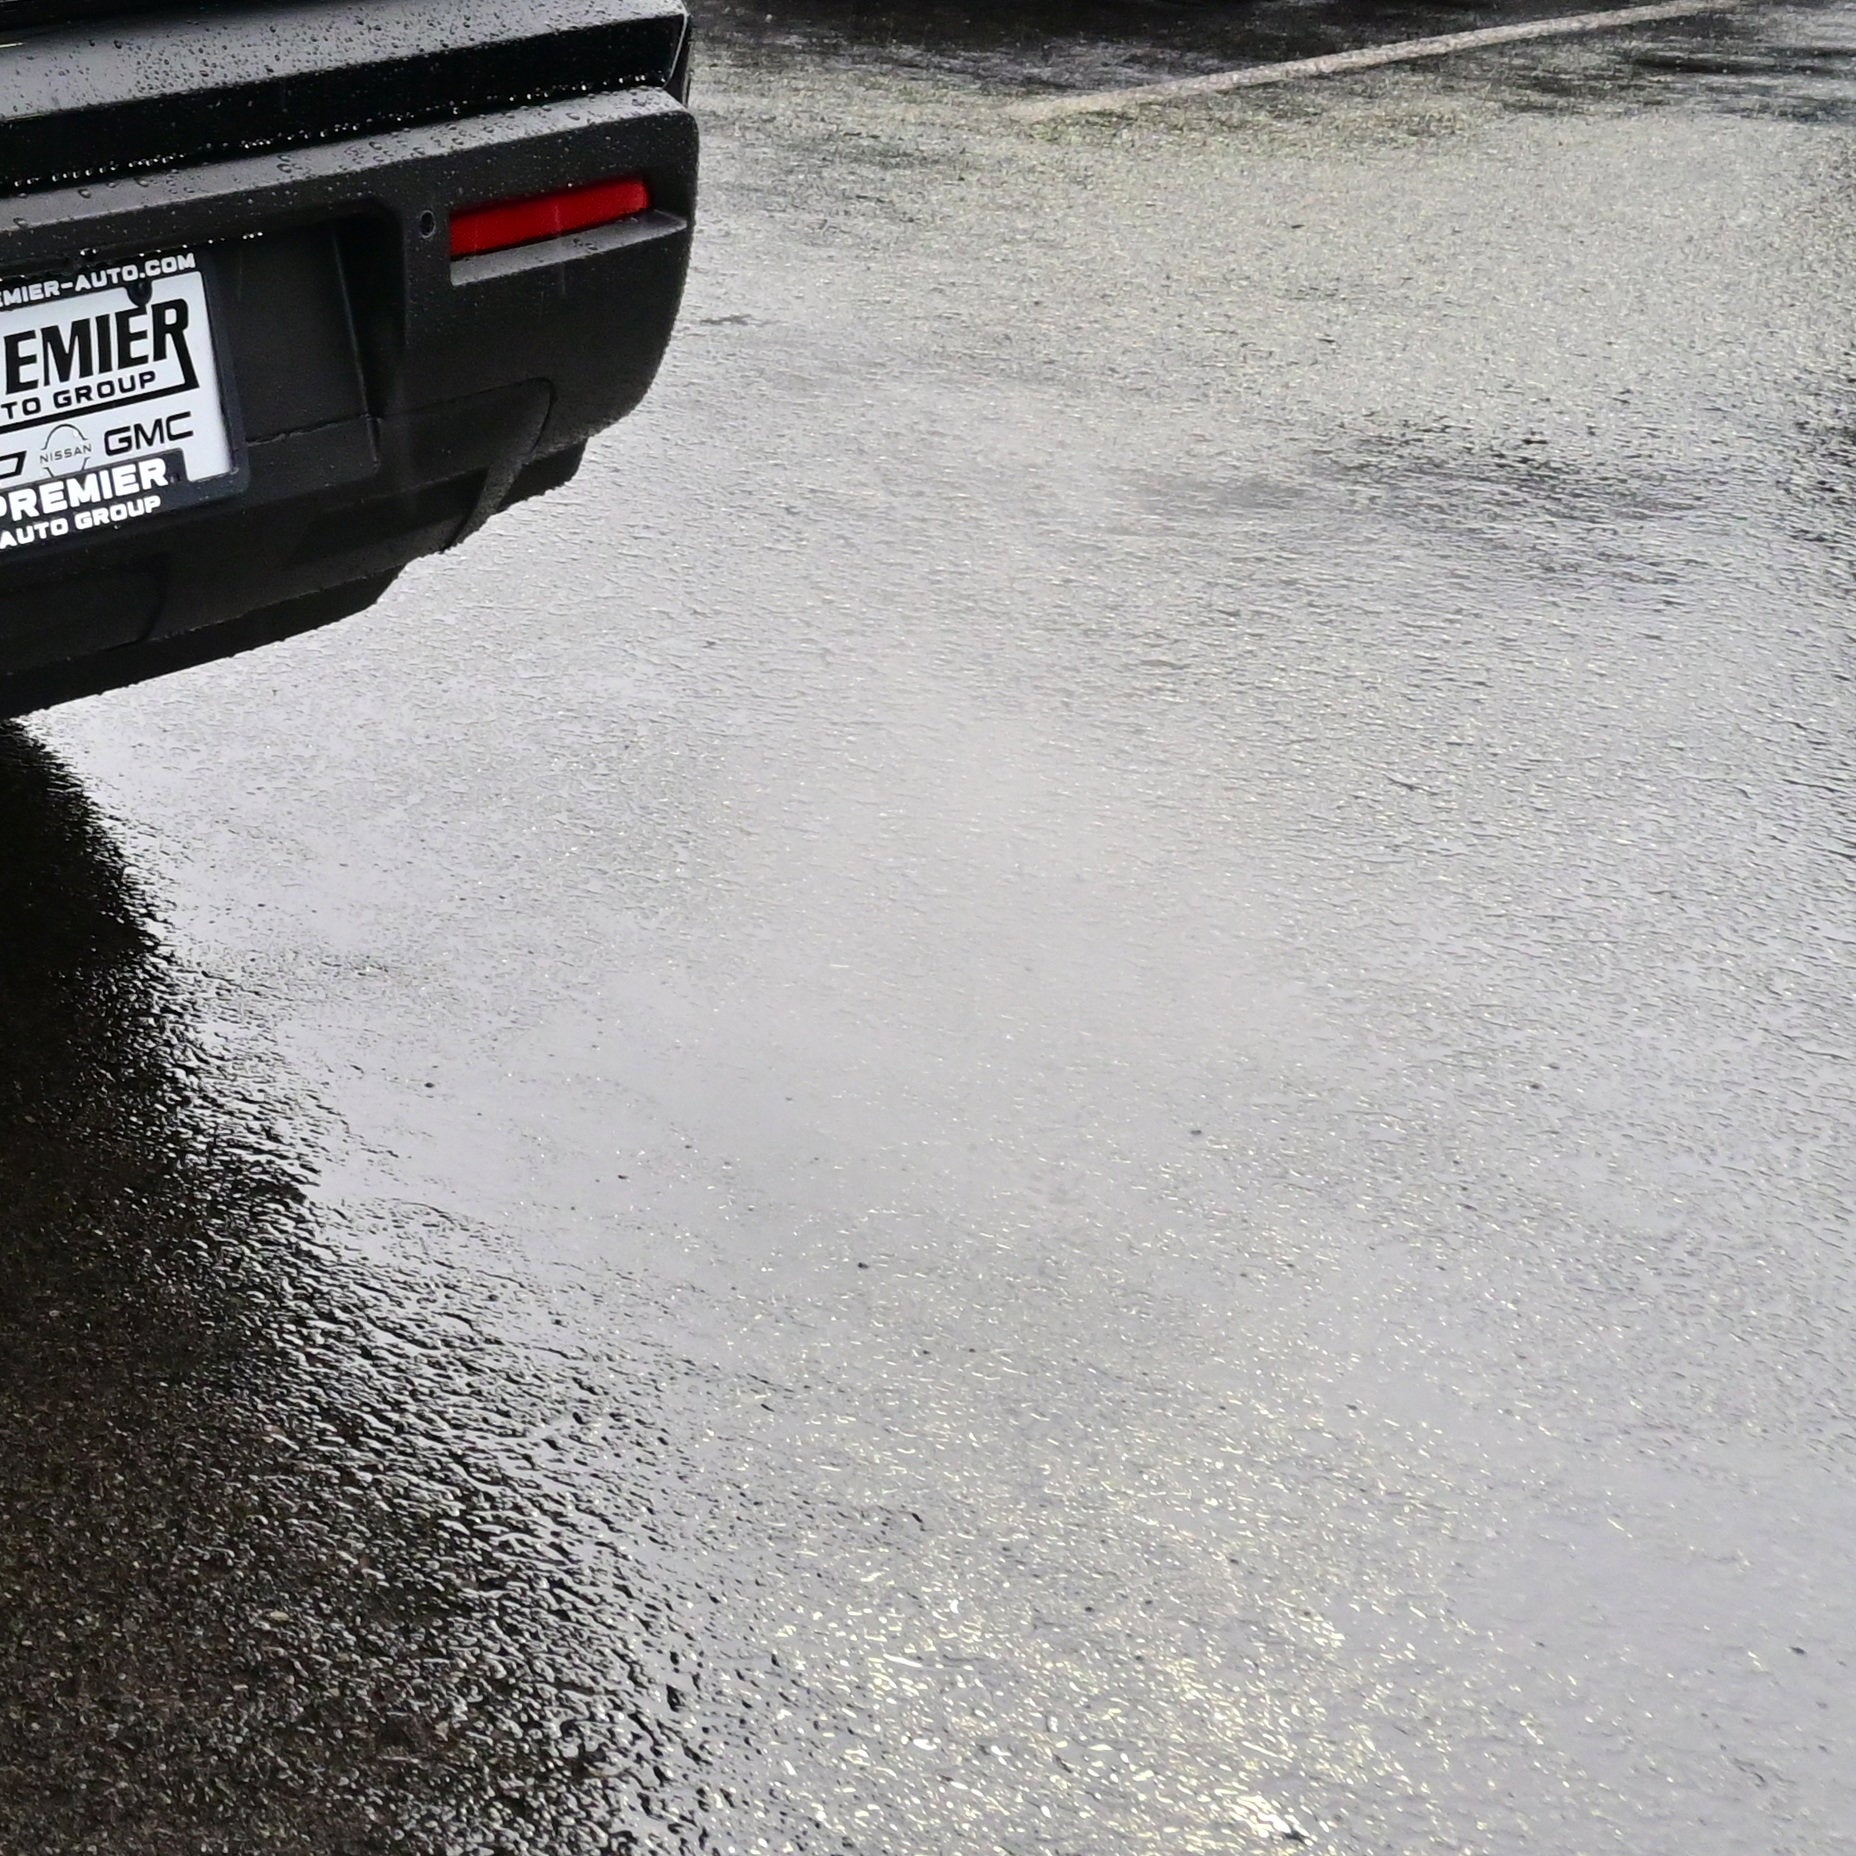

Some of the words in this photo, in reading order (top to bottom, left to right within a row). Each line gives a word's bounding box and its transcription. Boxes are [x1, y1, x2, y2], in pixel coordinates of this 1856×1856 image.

[53, 370, 157, 409] GROUP
[104, 411, 194, 456] GMC
[39, 443, 93, 464] NISSAN
[74, 495, 161, 531] GROUP
